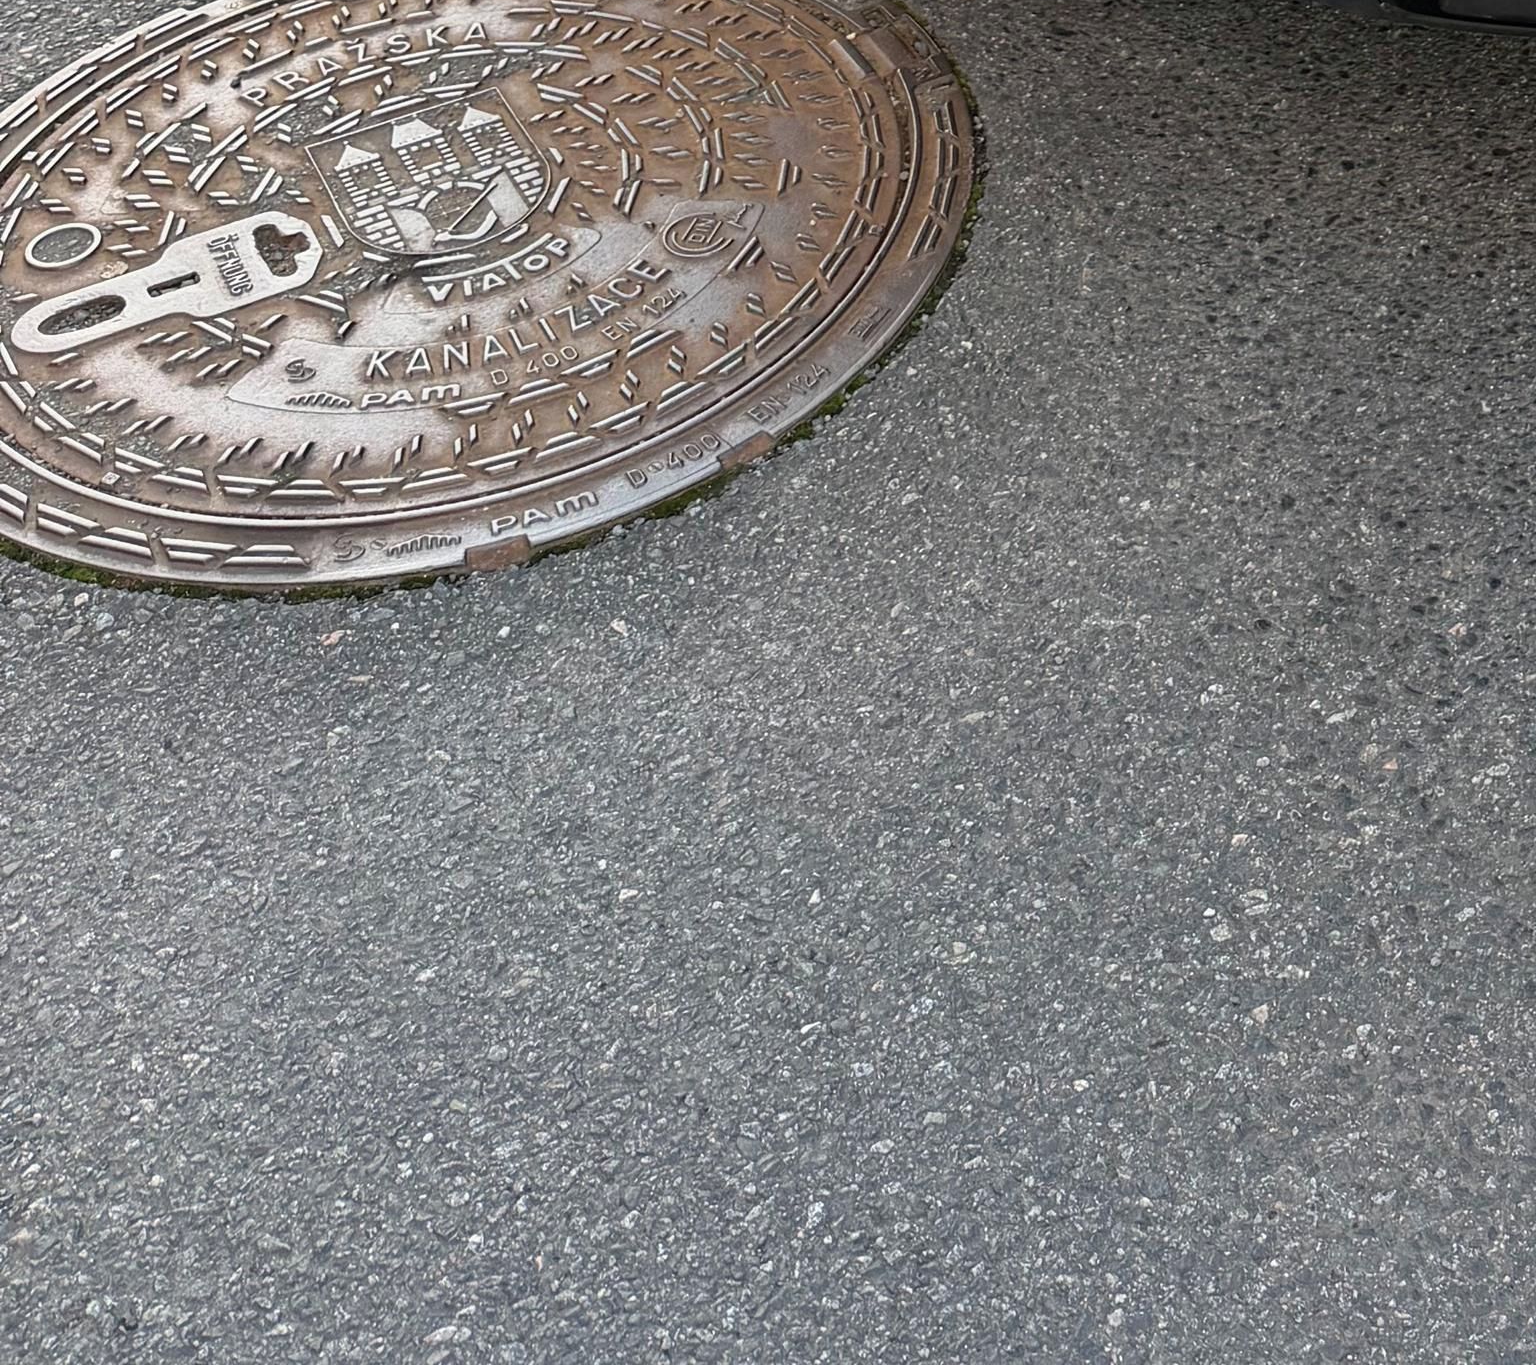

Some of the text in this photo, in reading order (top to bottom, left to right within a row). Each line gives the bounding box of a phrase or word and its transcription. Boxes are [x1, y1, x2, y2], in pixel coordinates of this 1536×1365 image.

[240, 20, 489, 107] PRAŽSKA
[366, 258, 671, 379] KANALIZACE
[526, 344, 579, 376] 400
[602, 316, 640, 342] EN
[642, 286, 686, 317] 124
[666, 433, 722, 468] 400
[748, 394, 787, 424] EN
[787, 362, 831, 395] 124
